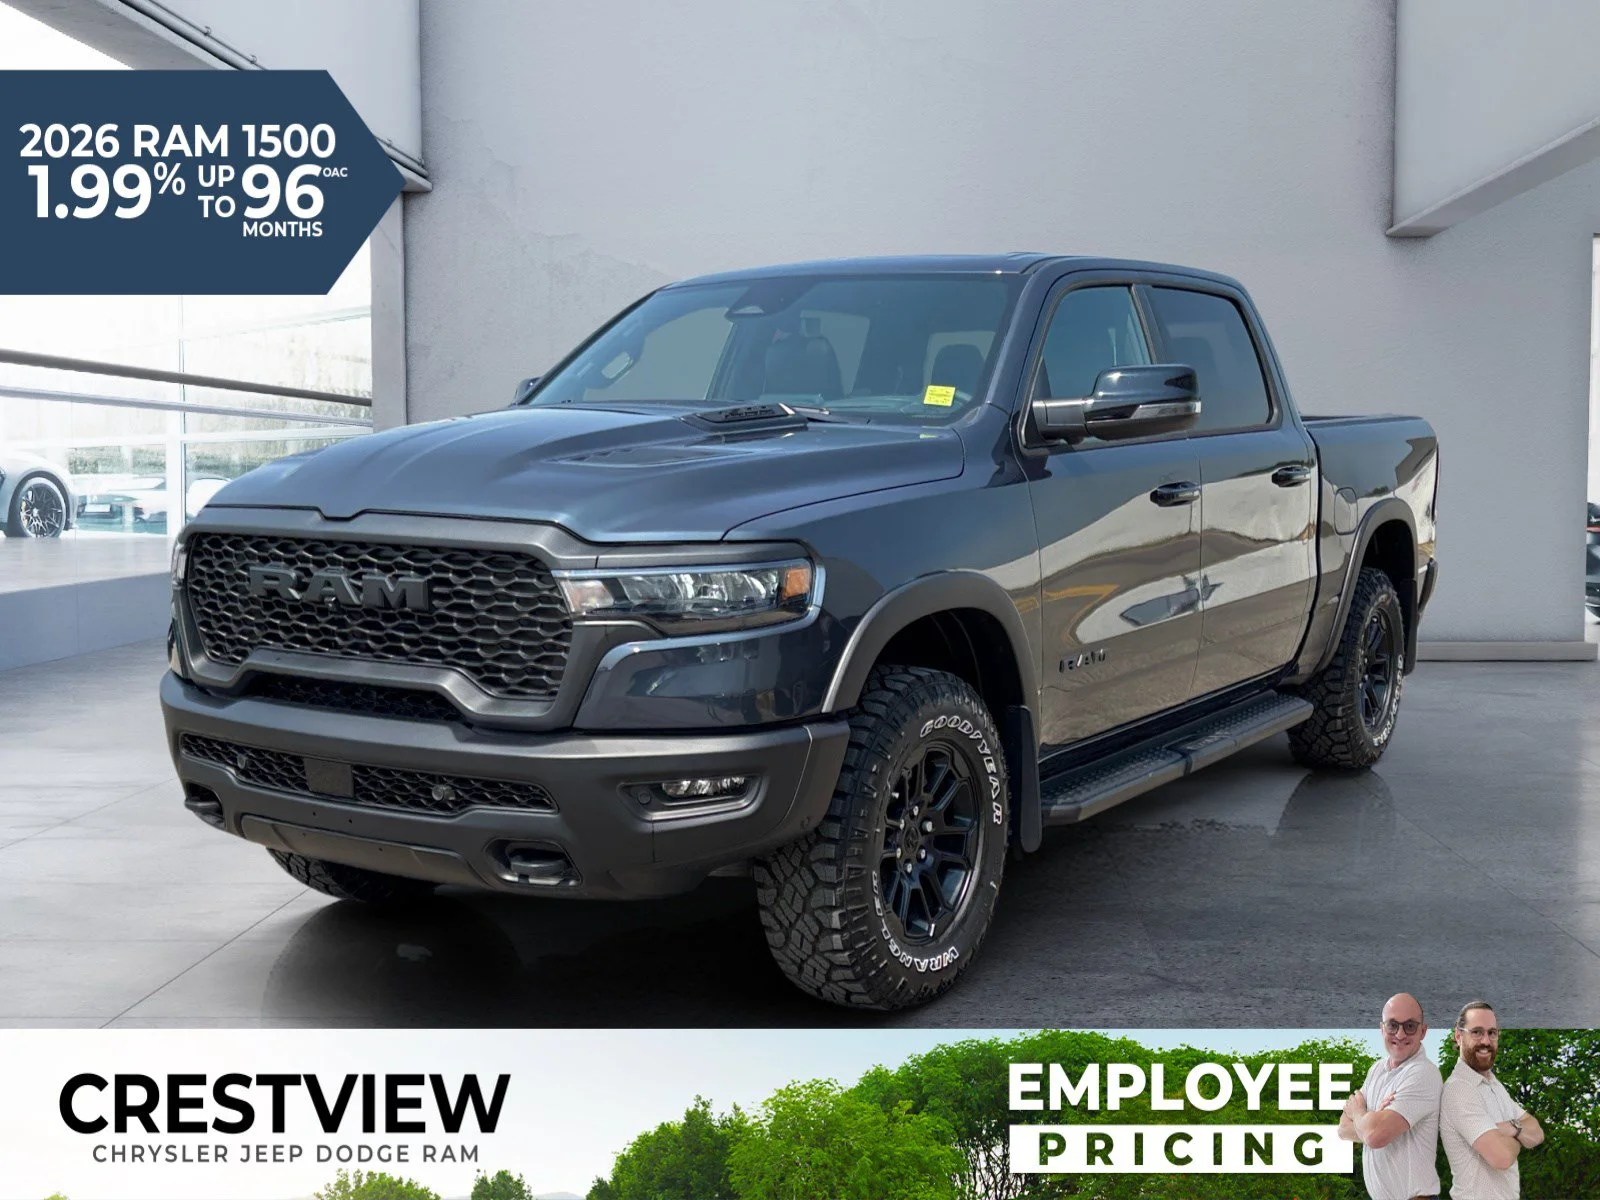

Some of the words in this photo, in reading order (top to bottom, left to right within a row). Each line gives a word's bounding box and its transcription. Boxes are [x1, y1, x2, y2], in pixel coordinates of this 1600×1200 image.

[249, 565, 434, 611] RAM
[920, 715, 1003, 825] GOODYEAR
[872, 870, 960, 972] WRANGLER
